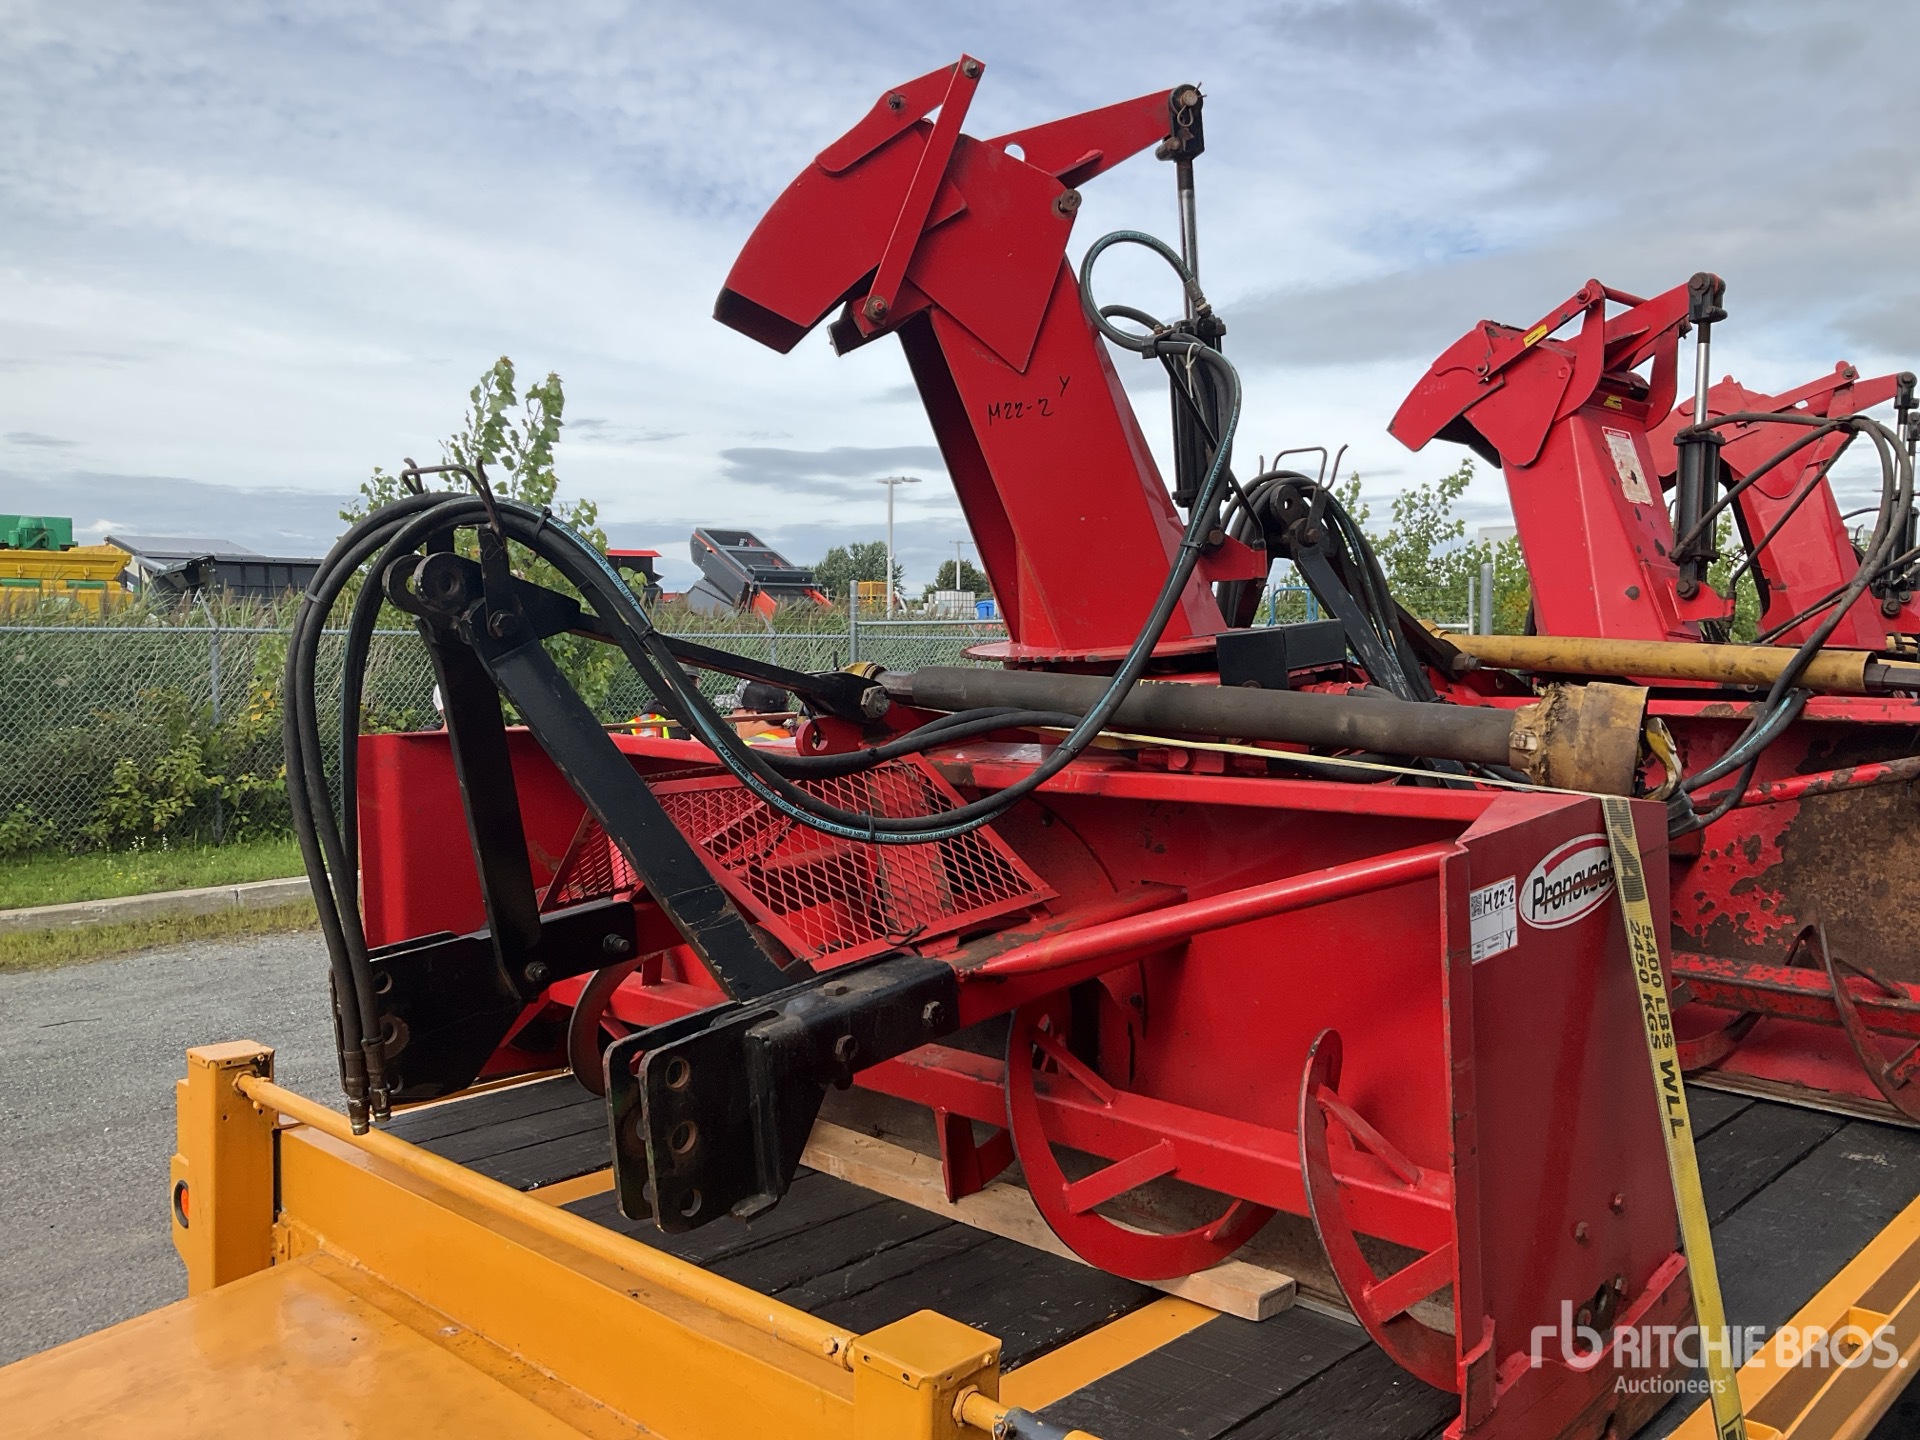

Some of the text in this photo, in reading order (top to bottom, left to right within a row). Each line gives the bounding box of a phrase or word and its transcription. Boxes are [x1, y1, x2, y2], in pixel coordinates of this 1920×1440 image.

[1629, 918, 1662, 1050] 2450 KGS
[1641, 925, 1685, 1139] 5400 LBS WLL
